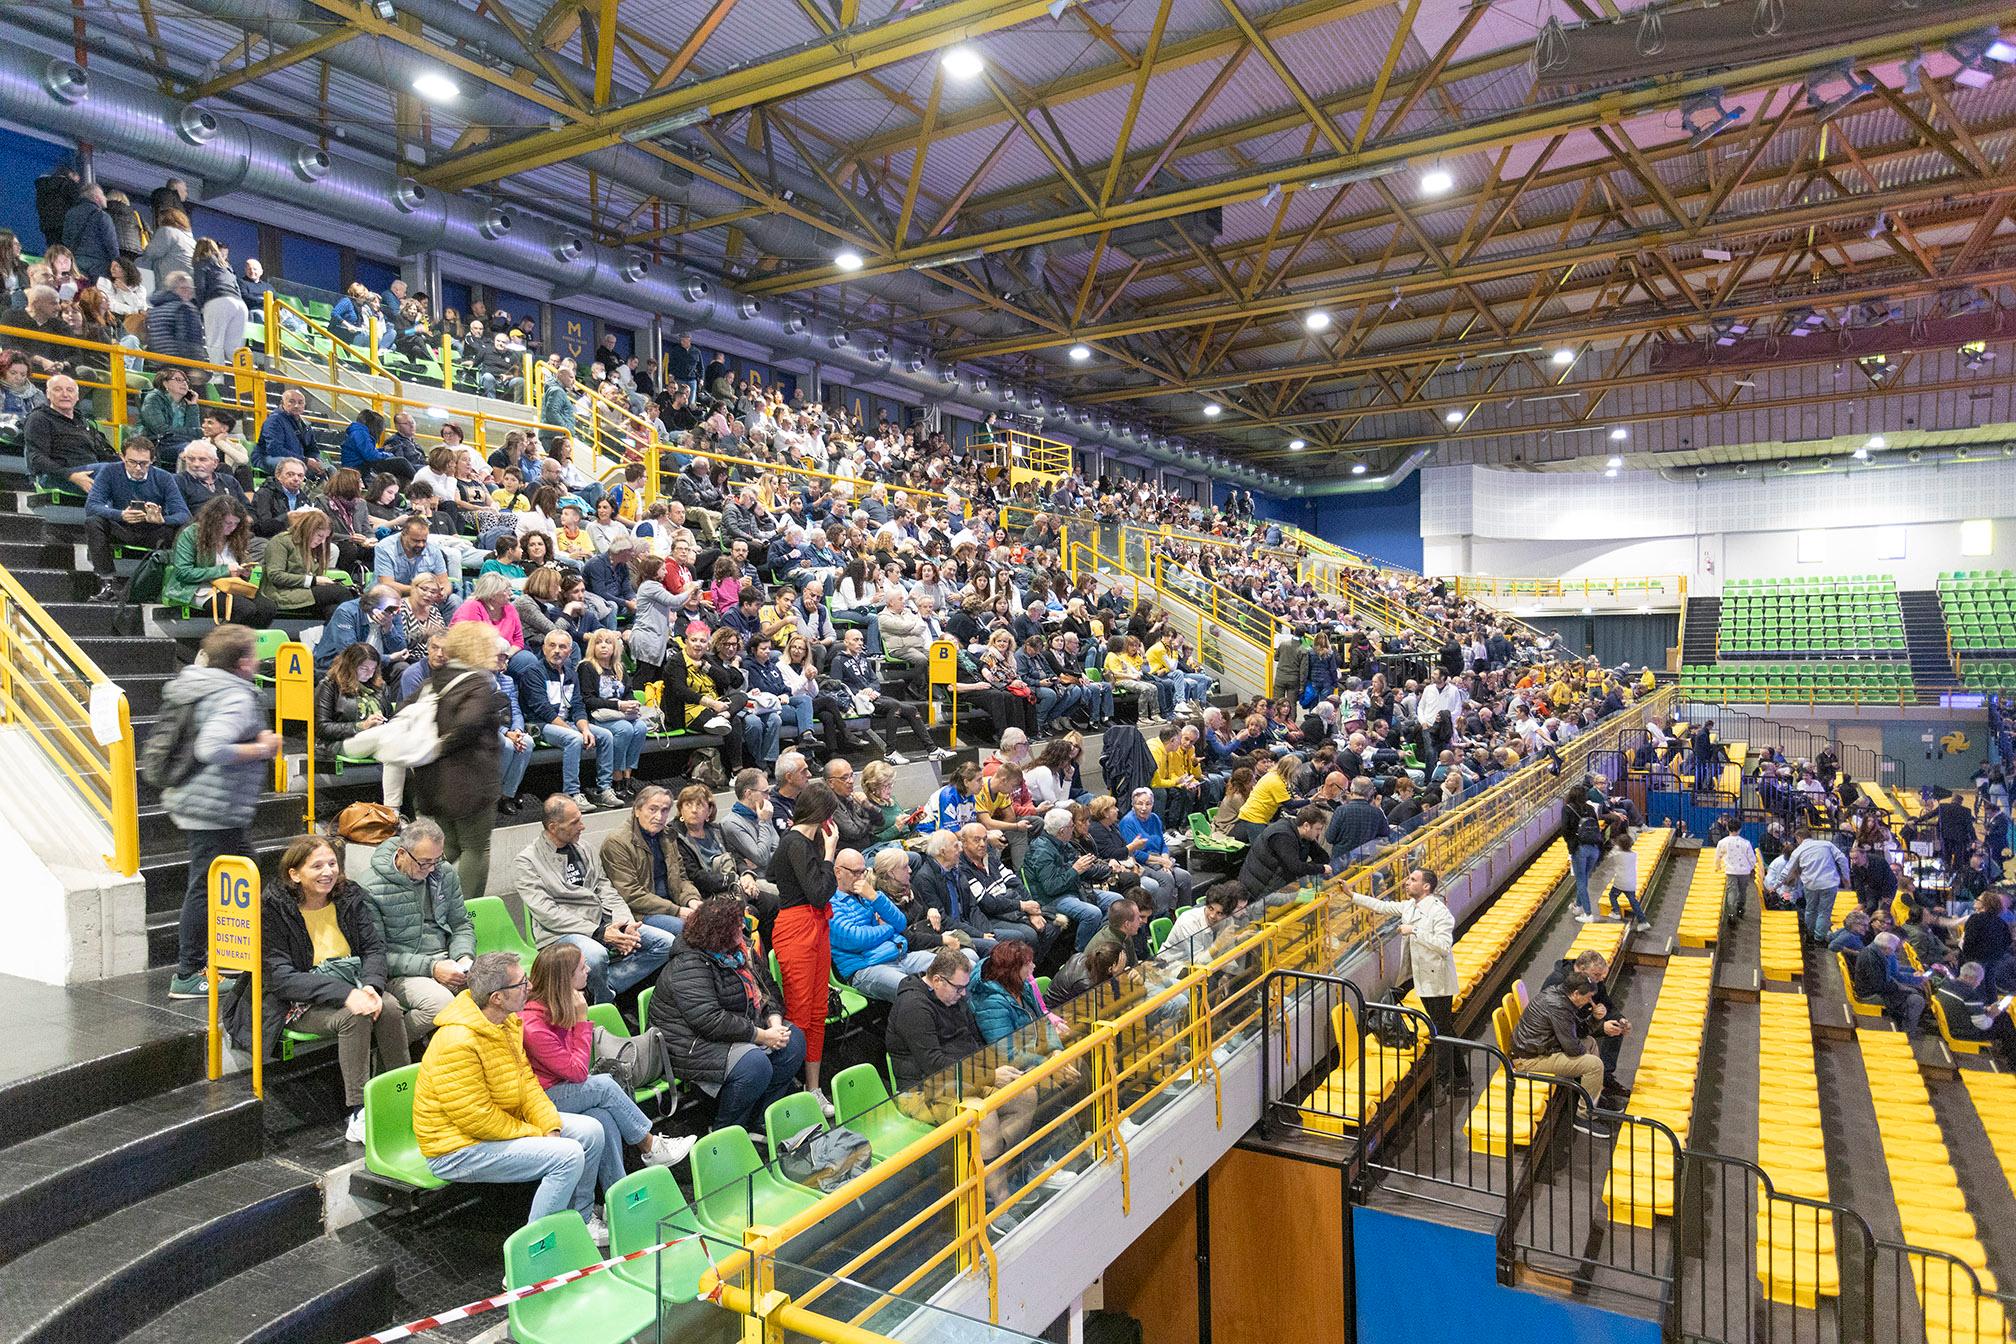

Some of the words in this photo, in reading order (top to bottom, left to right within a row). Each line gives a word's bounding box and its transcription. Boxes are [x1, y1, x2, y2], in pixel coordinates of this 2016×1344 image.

[567, 320, 581, 337] M
[240, 354, 247, 366] E
[940, 647, 949, 659] B
[289, 654, 302, 675] A
[220, 871, 251, 909] DG
[216, 916, 251, 929] SETTORE
[216, 932, 251, 946] DISTINTI
[216, 948, 251, 961] NUMERATI
[396, 1082, 408, 1092] 32
[786, 1110, 790, 1118] 8
[713, 1147, 718, 1155] 6
[634, 1192, 640, 1201] 4
[540, 1239, 546, 1250] 2
